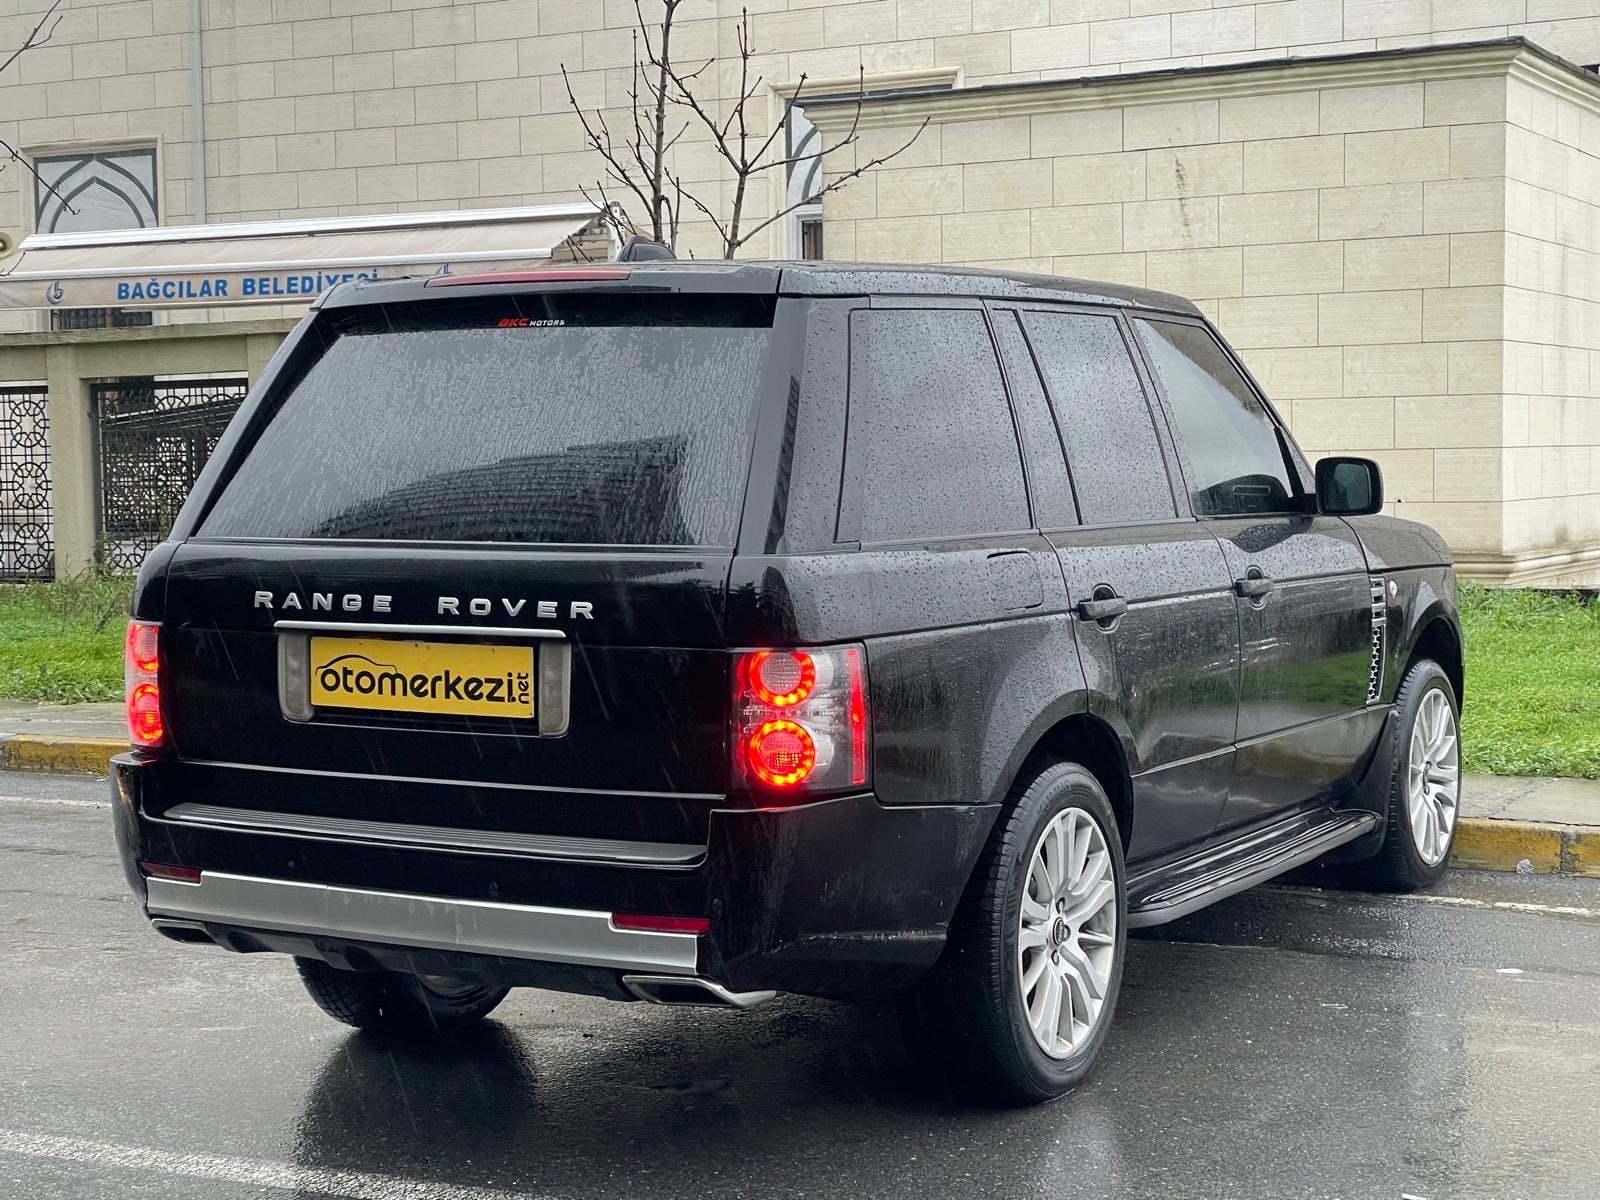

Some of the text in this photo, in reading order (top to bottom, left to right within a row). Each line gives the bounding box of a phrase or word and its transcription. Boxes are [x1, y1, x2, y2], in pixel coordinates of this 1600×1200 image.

[117, 278, 228, 300] BAĞCILAR
[498, 318, 565, 327] BKC MOTORS
[253, 591, 594, 619] RANGE ROVER
